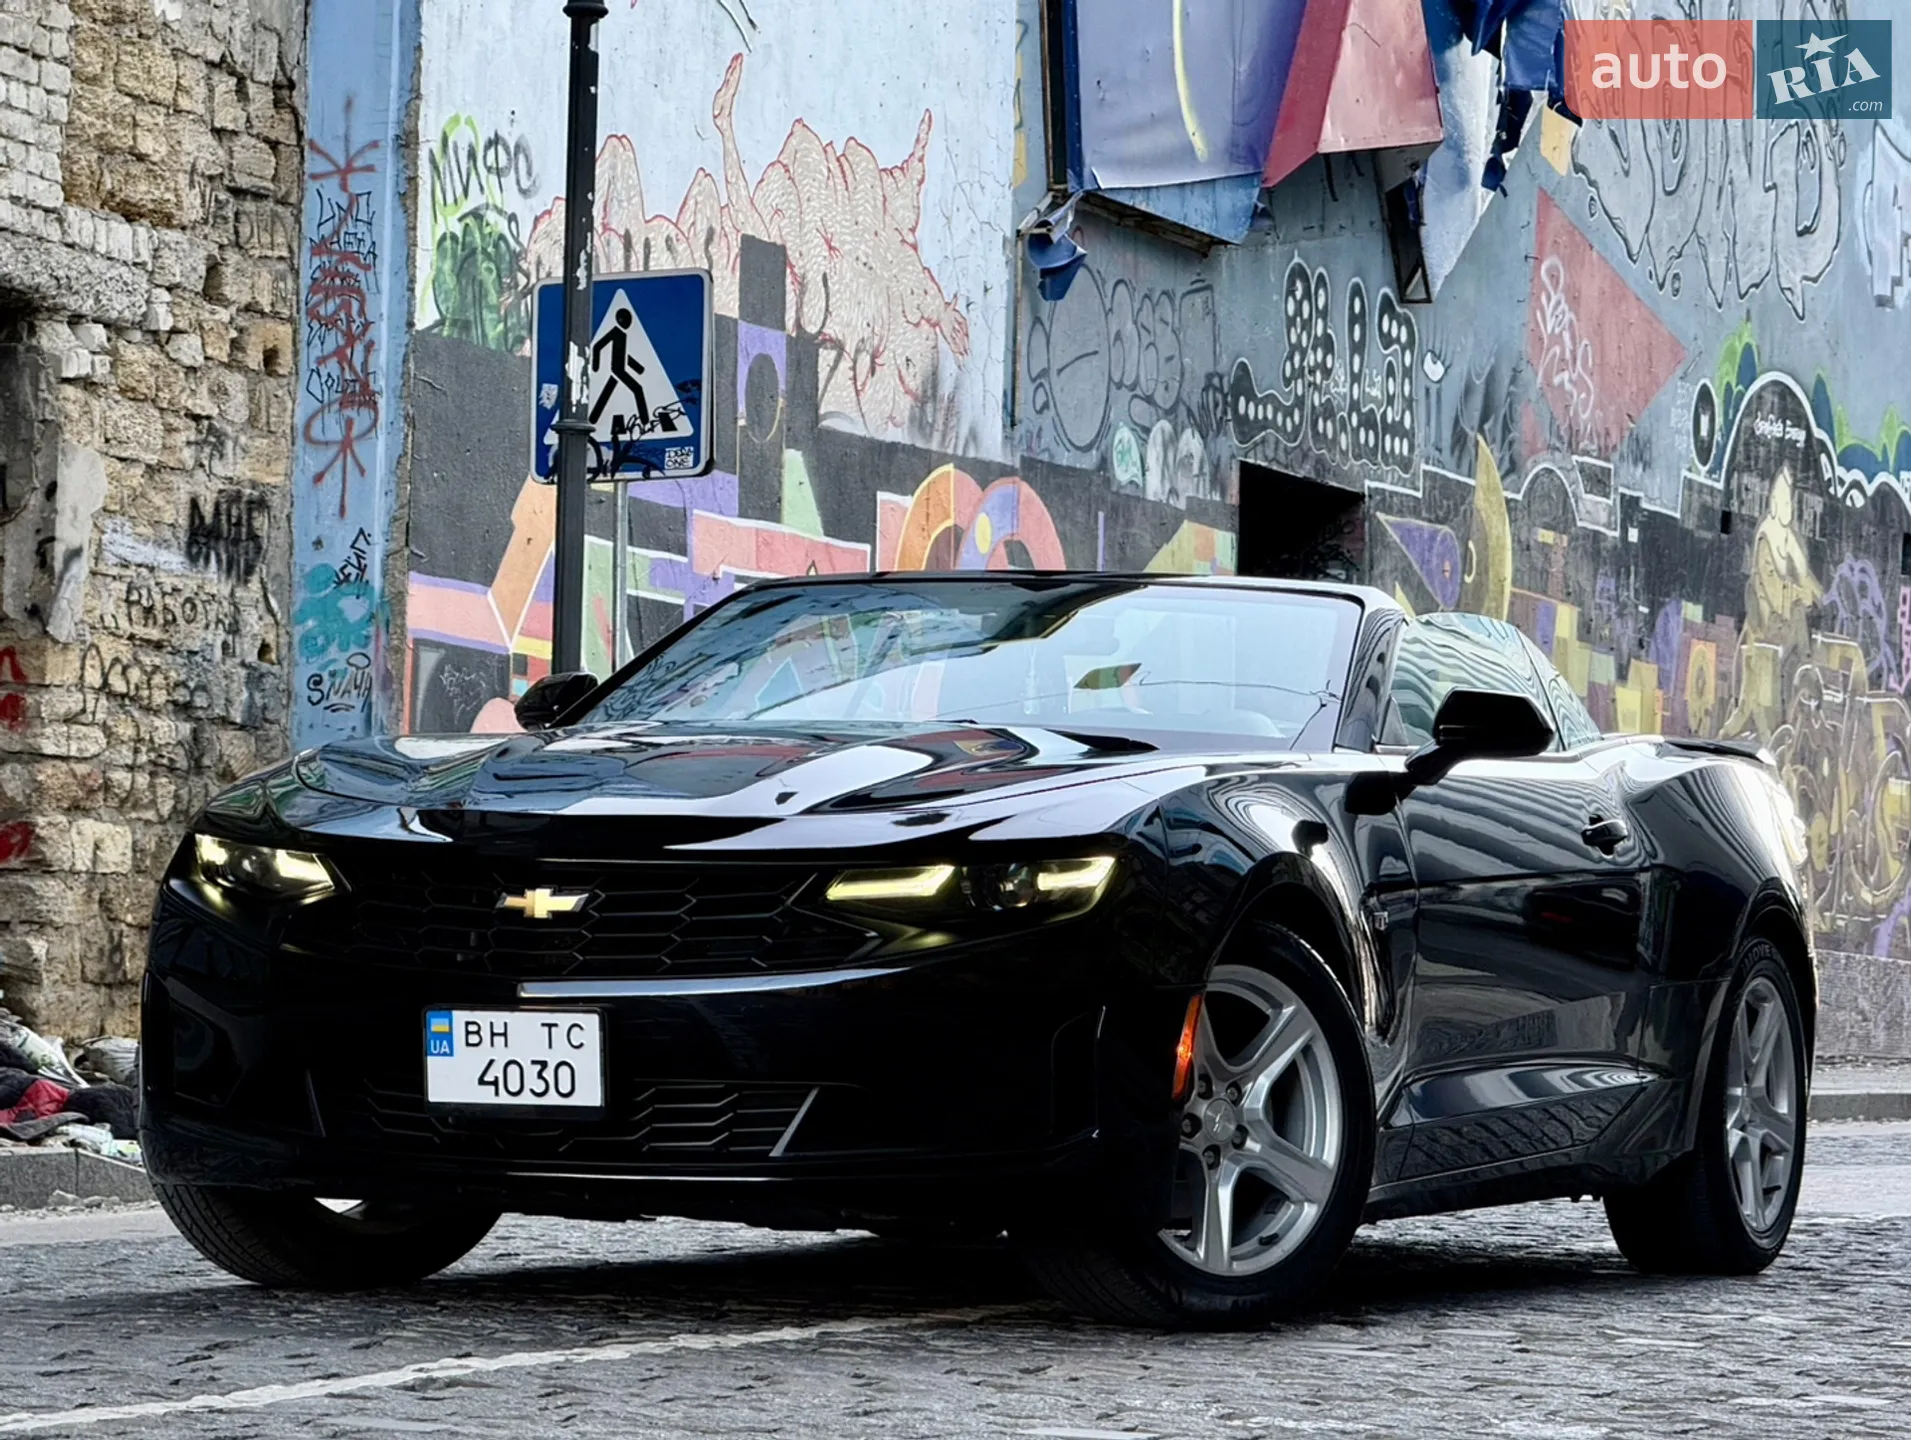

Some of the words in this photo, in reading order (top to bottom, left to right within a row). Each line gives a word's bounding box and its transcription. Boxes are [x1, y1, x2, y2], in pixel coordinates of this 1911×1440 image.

[430, 1040, 450, 1054] UA
[464, 1020, 509, 1048] BH
[541, 1022, 585, 1050] TC
[477, 1058, 576, 1099] 4030
